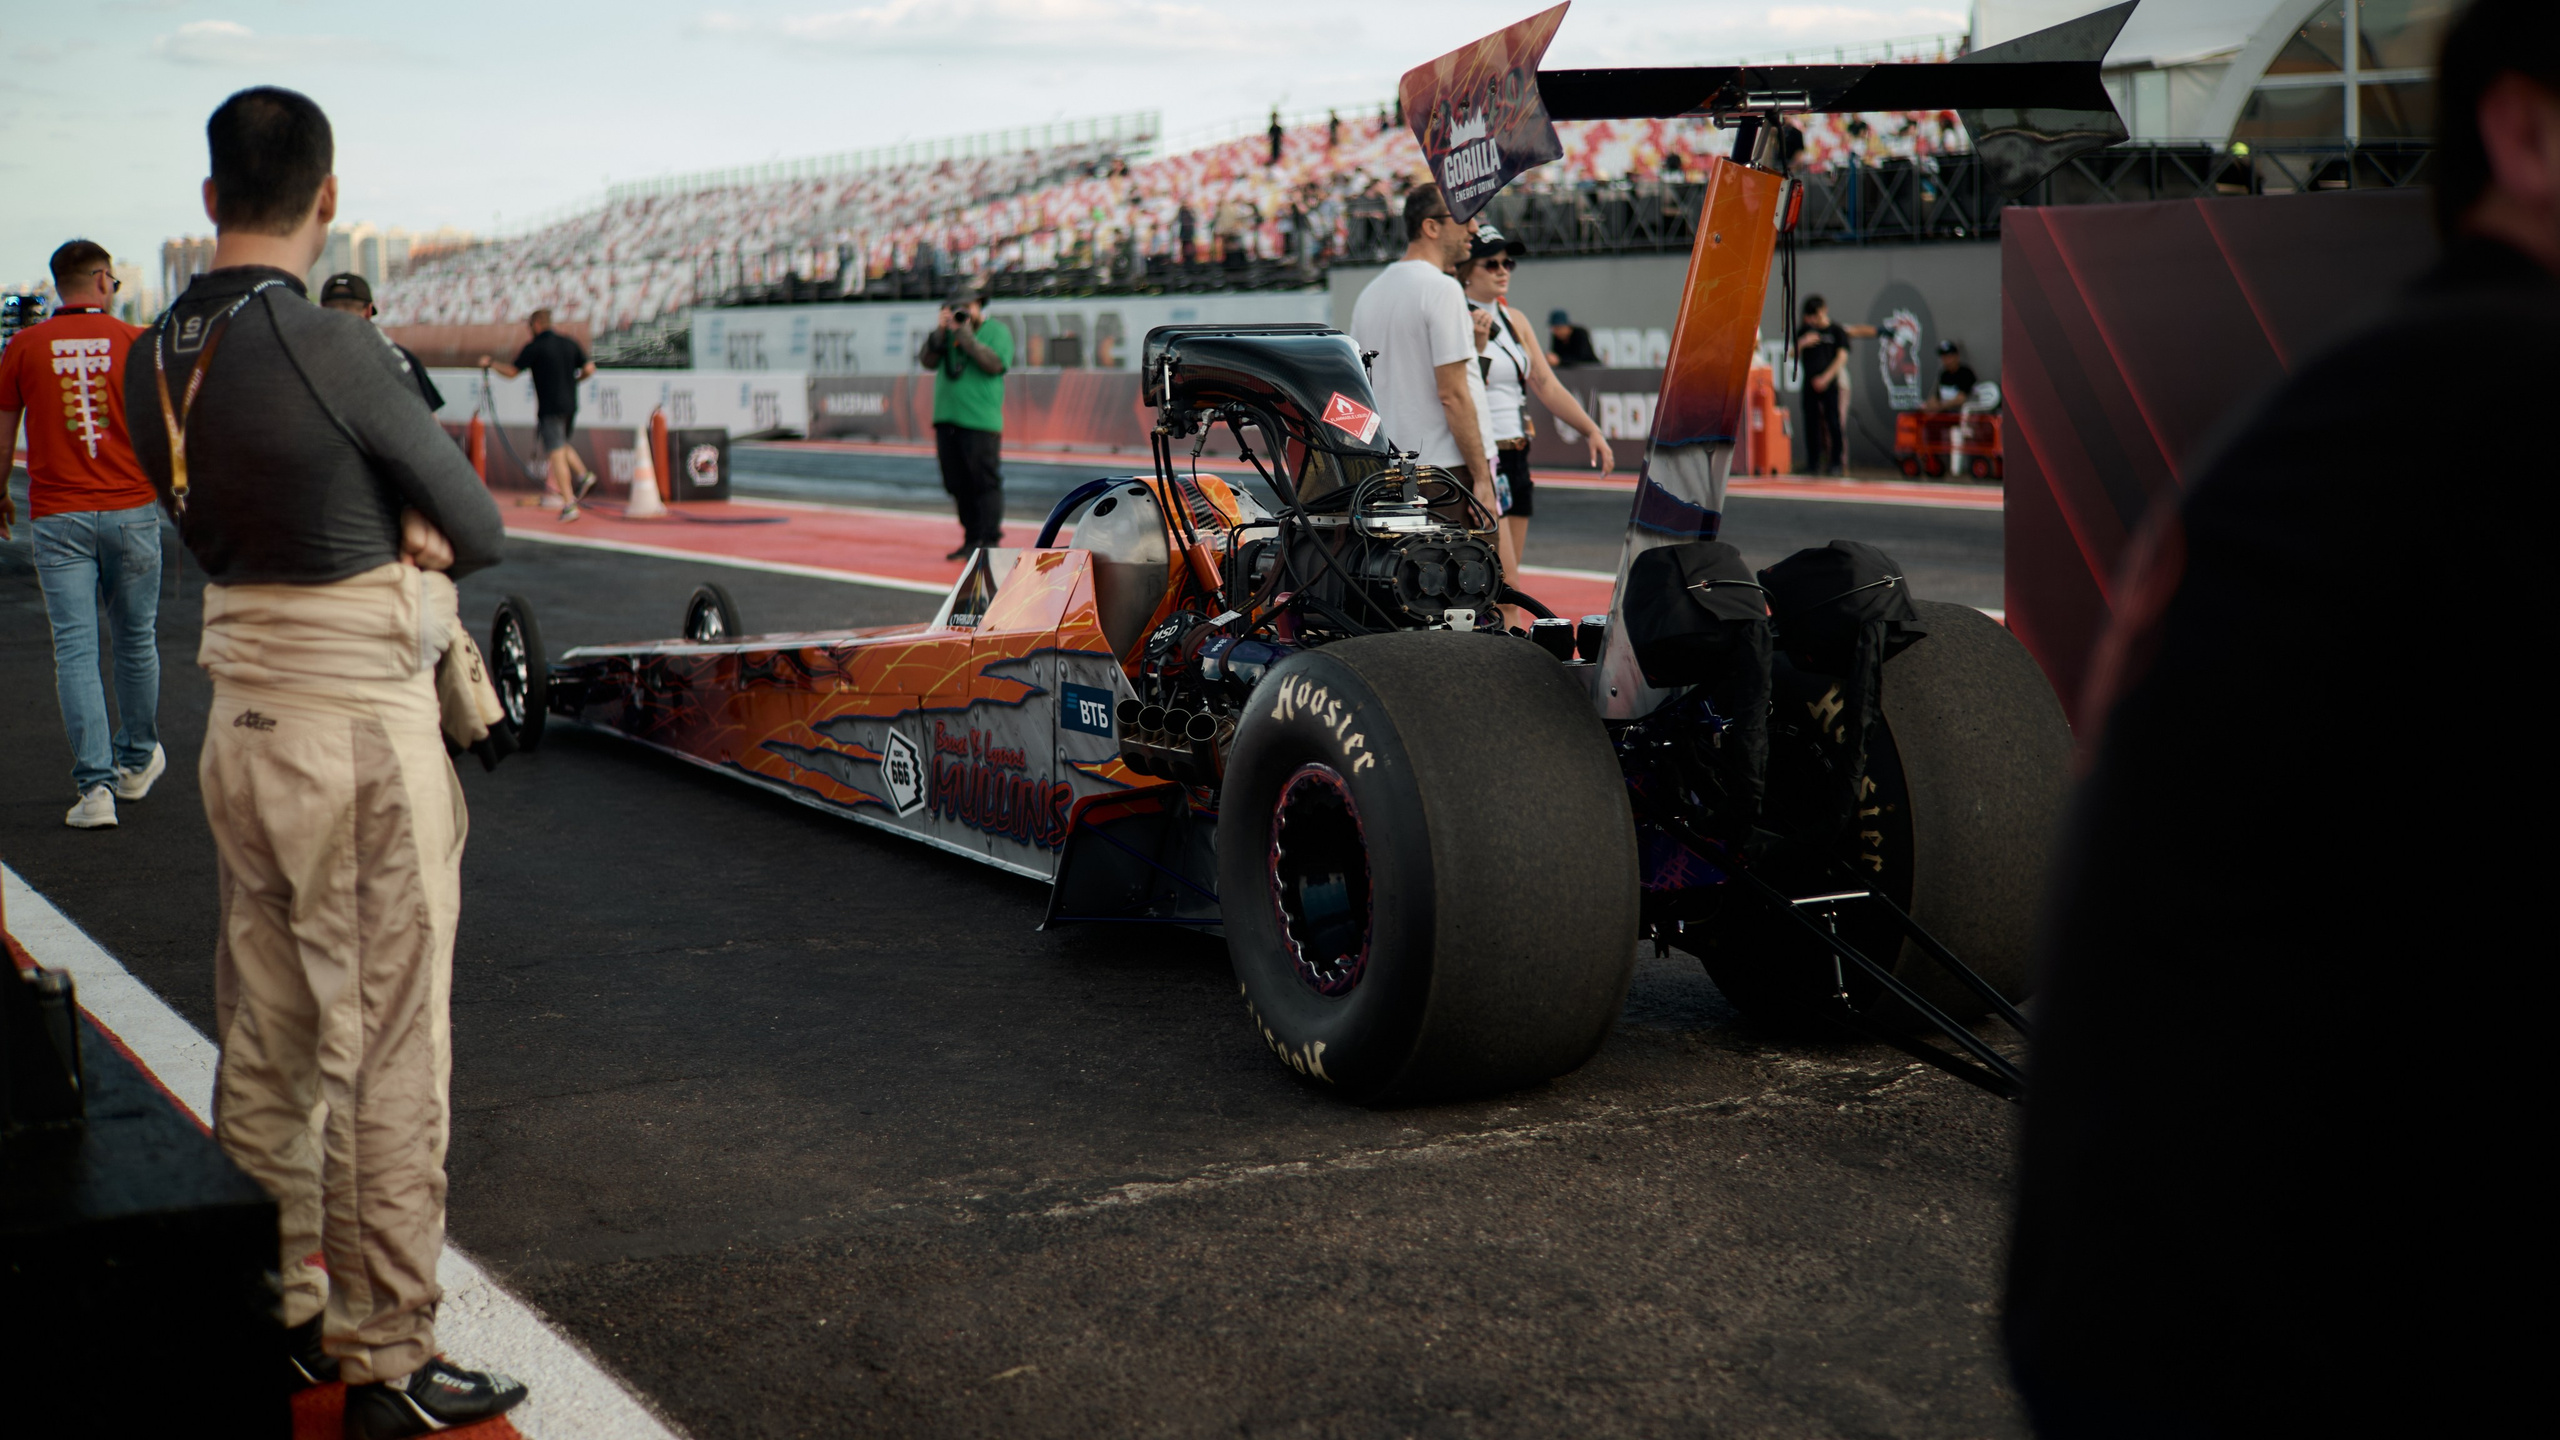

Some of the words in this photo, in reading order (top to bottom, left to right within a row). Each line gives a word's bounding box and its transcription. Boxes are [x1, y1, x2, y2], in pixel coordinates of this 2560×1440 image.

[1443, 138, 1501, 189] GORILLA
[1455, 187, 1477, 203] ENERGY
[1477, 179, 1496, 195] DRINK
[1150, 624, 1178, 642] MSD
[1079, 699, 1109, 729] ВТБ
[1270, 673, 1376, 775] Hoosier
[984, 729, 1026, 772] Lynne
[891, 760, 910, 786] 666
[1803, 682, 1890, 873] Hosier
[930, 754, 1074, 852] MULLINS
